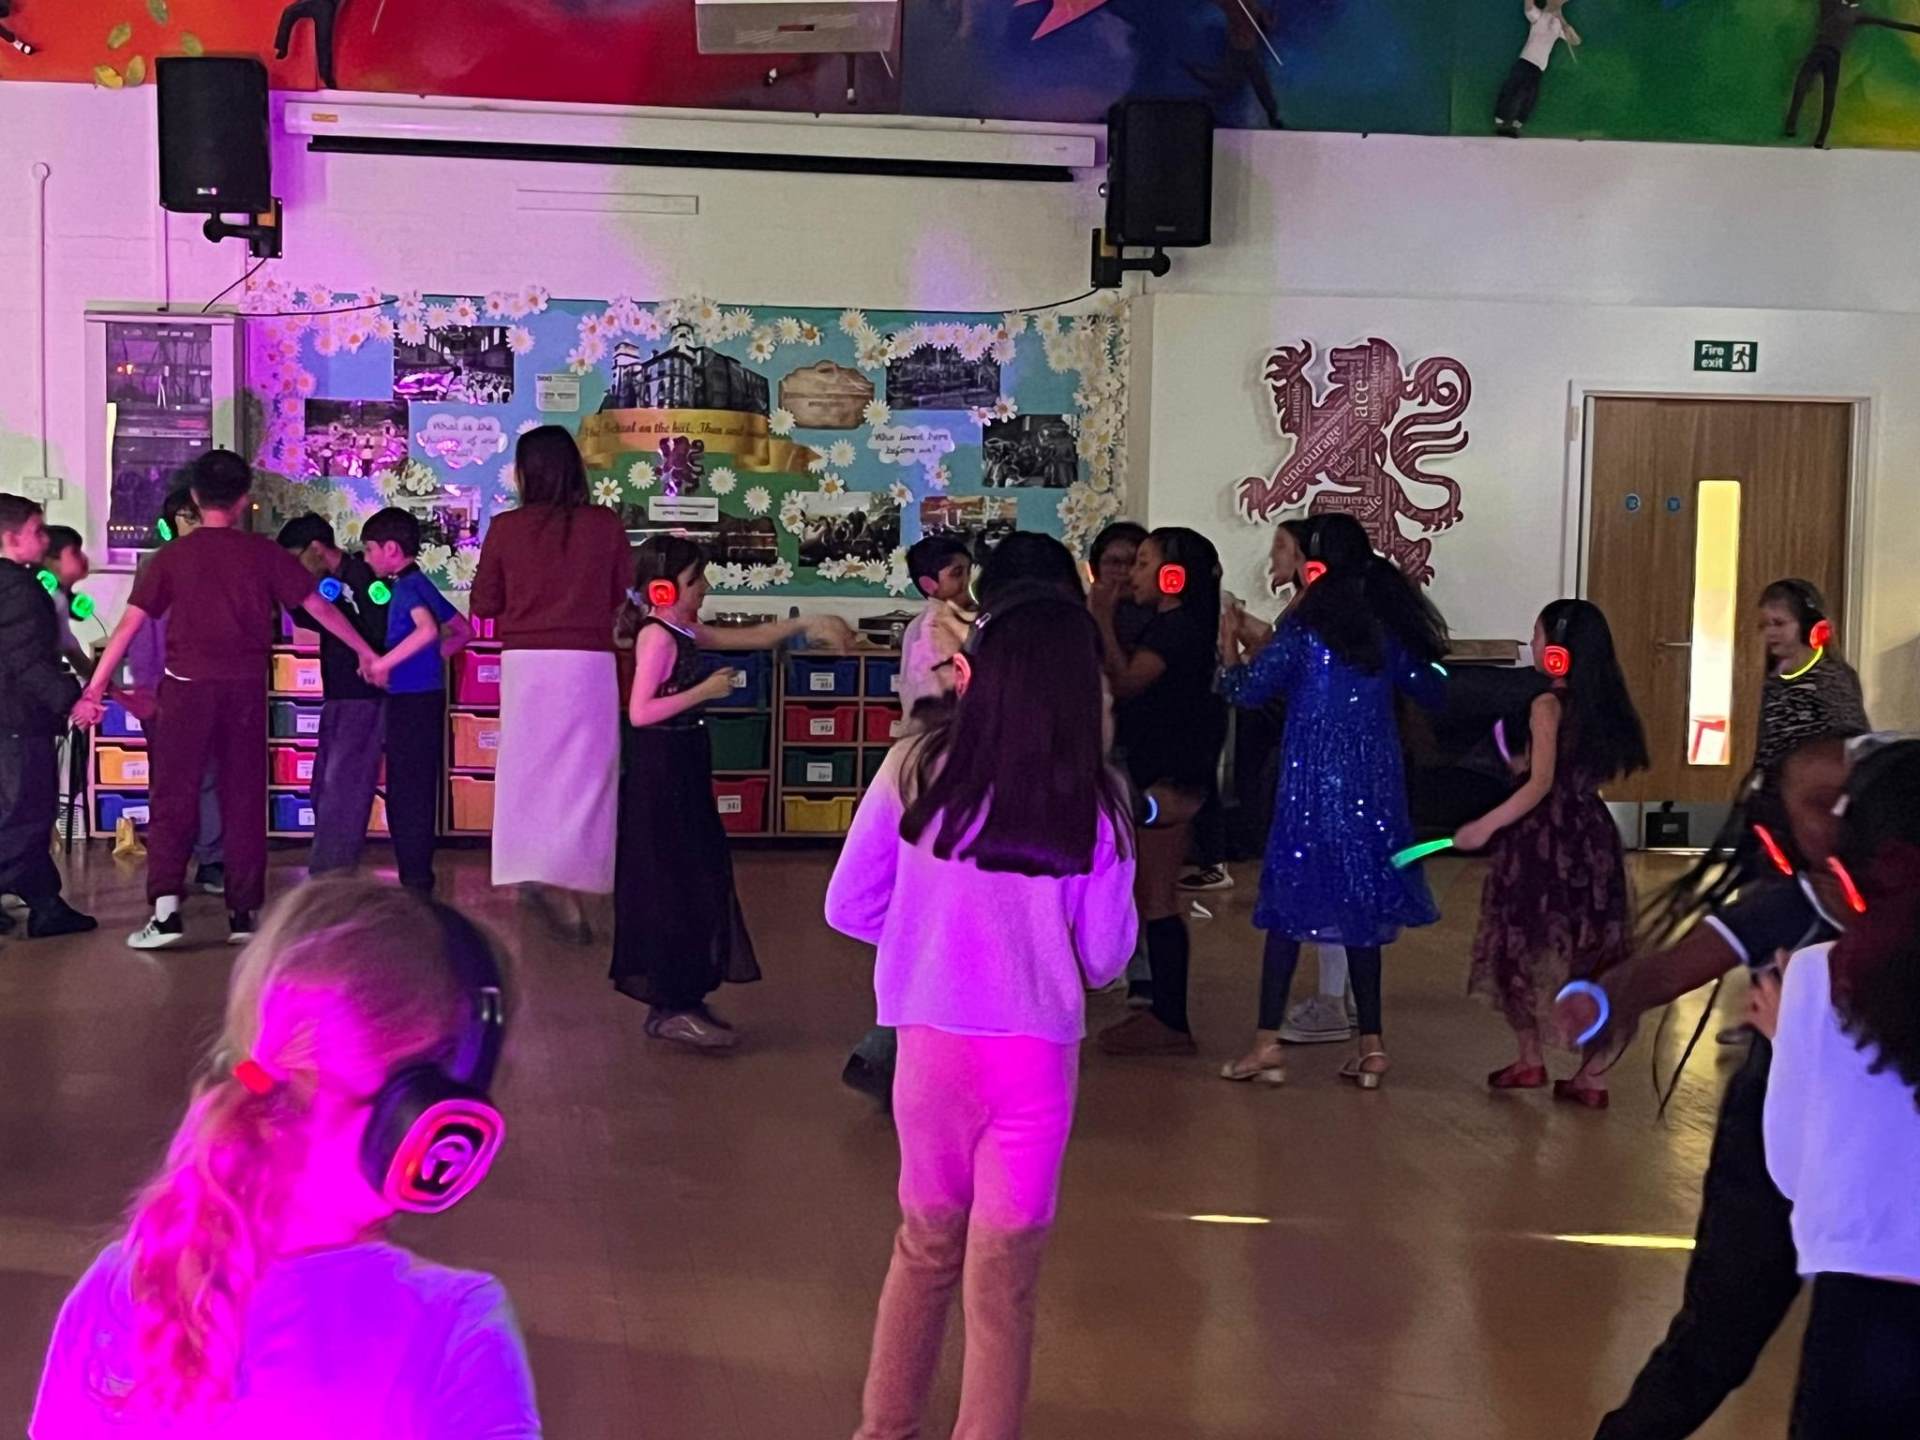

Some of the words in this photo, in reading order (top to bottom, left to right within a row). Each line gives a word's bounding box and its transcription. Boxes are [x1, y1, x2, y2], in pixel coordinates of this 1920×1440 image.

[1701, 343, 1724, 356] Fire
[1701, 357, 1723, 369] exit
[1353, 379, 1369, 418] ace
[653, 422, 669, 433] the
[1281, 425, 1342, 487] encourage
[1316, 495, 1369, 505] manners
